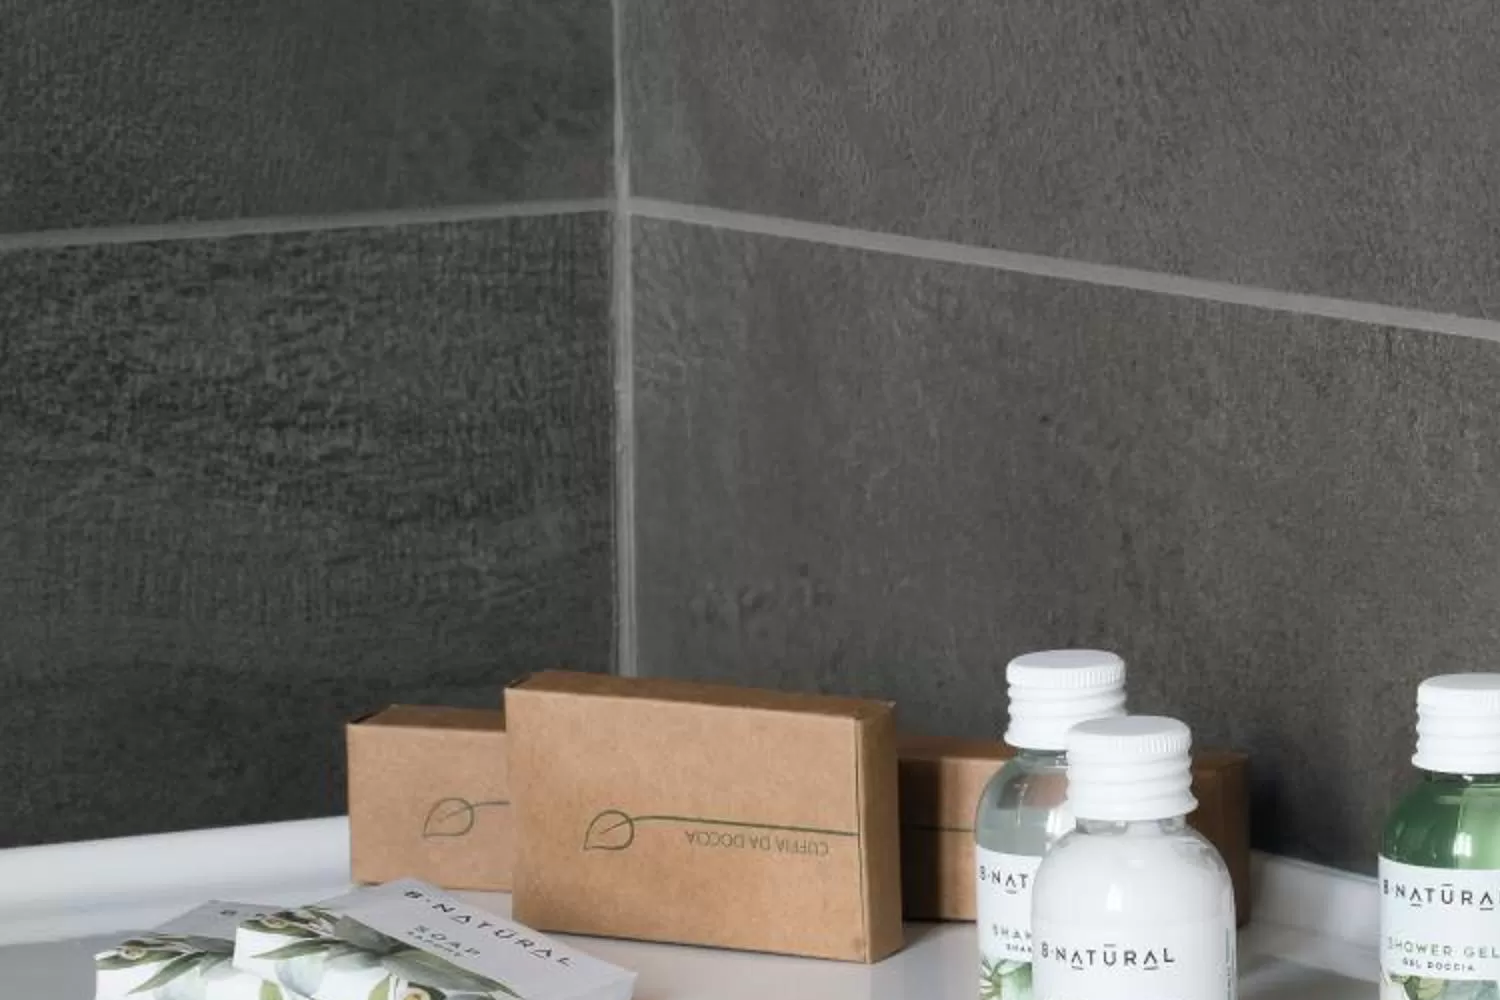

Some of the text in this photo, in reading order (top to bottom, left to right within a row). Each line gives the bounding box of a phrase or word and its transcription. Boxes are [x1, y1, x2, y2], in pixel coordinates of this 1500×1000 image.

[684, 831, 829, 857] CUFFIA DA DOCCIA
[1427, 960, 1475, 972] DOCCIA
